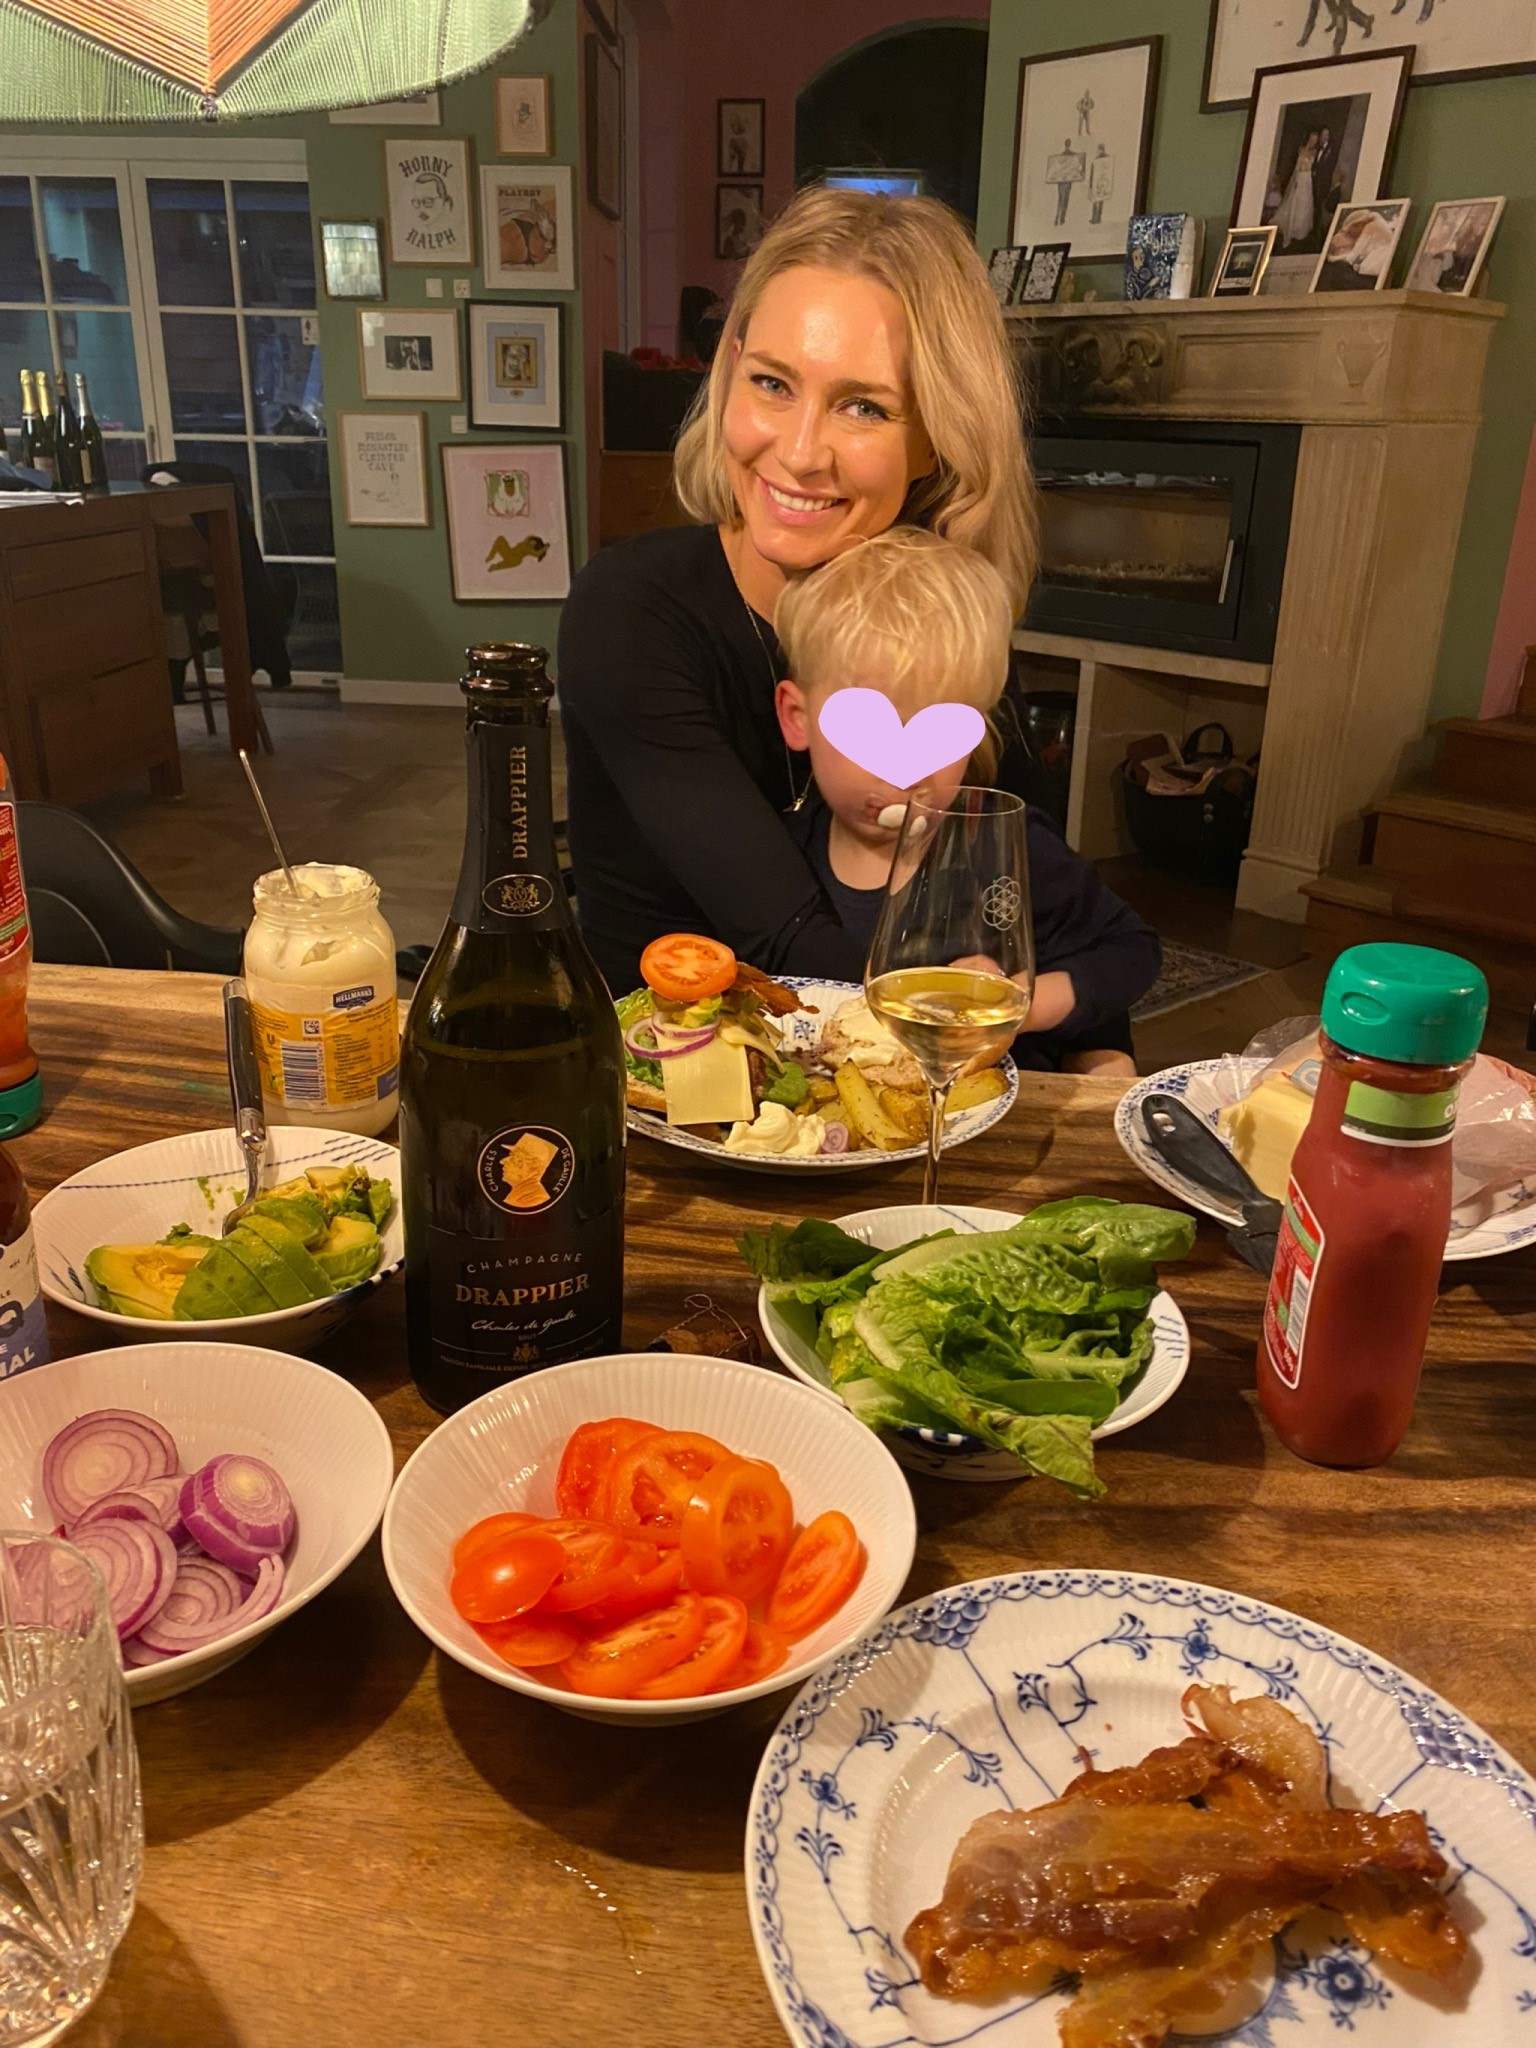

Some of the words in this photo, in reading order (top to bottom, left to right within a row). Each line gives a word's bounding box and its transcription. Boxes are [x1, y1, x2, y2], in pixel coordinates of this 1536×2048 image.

[398, 155, 454, 178] HORNY
[498, 188, 541, 197] PLAYBOY
[405, 227, 457, 249] RALPH
[365, 432, 398, 441] PRISON
[509, 745, 528, 860] DRAPPIER
[561, 1147, 571, 1160] DE
[484, 1149, 498, 1192] CHARLES
[552, 1160, 571, 1193] GAULLE
[466, 1252, 583, 1274] CHAMPAGNE
[455, 1272, 591, 1307] DRAPPIER
[523, 1319, 538, 1330] de
